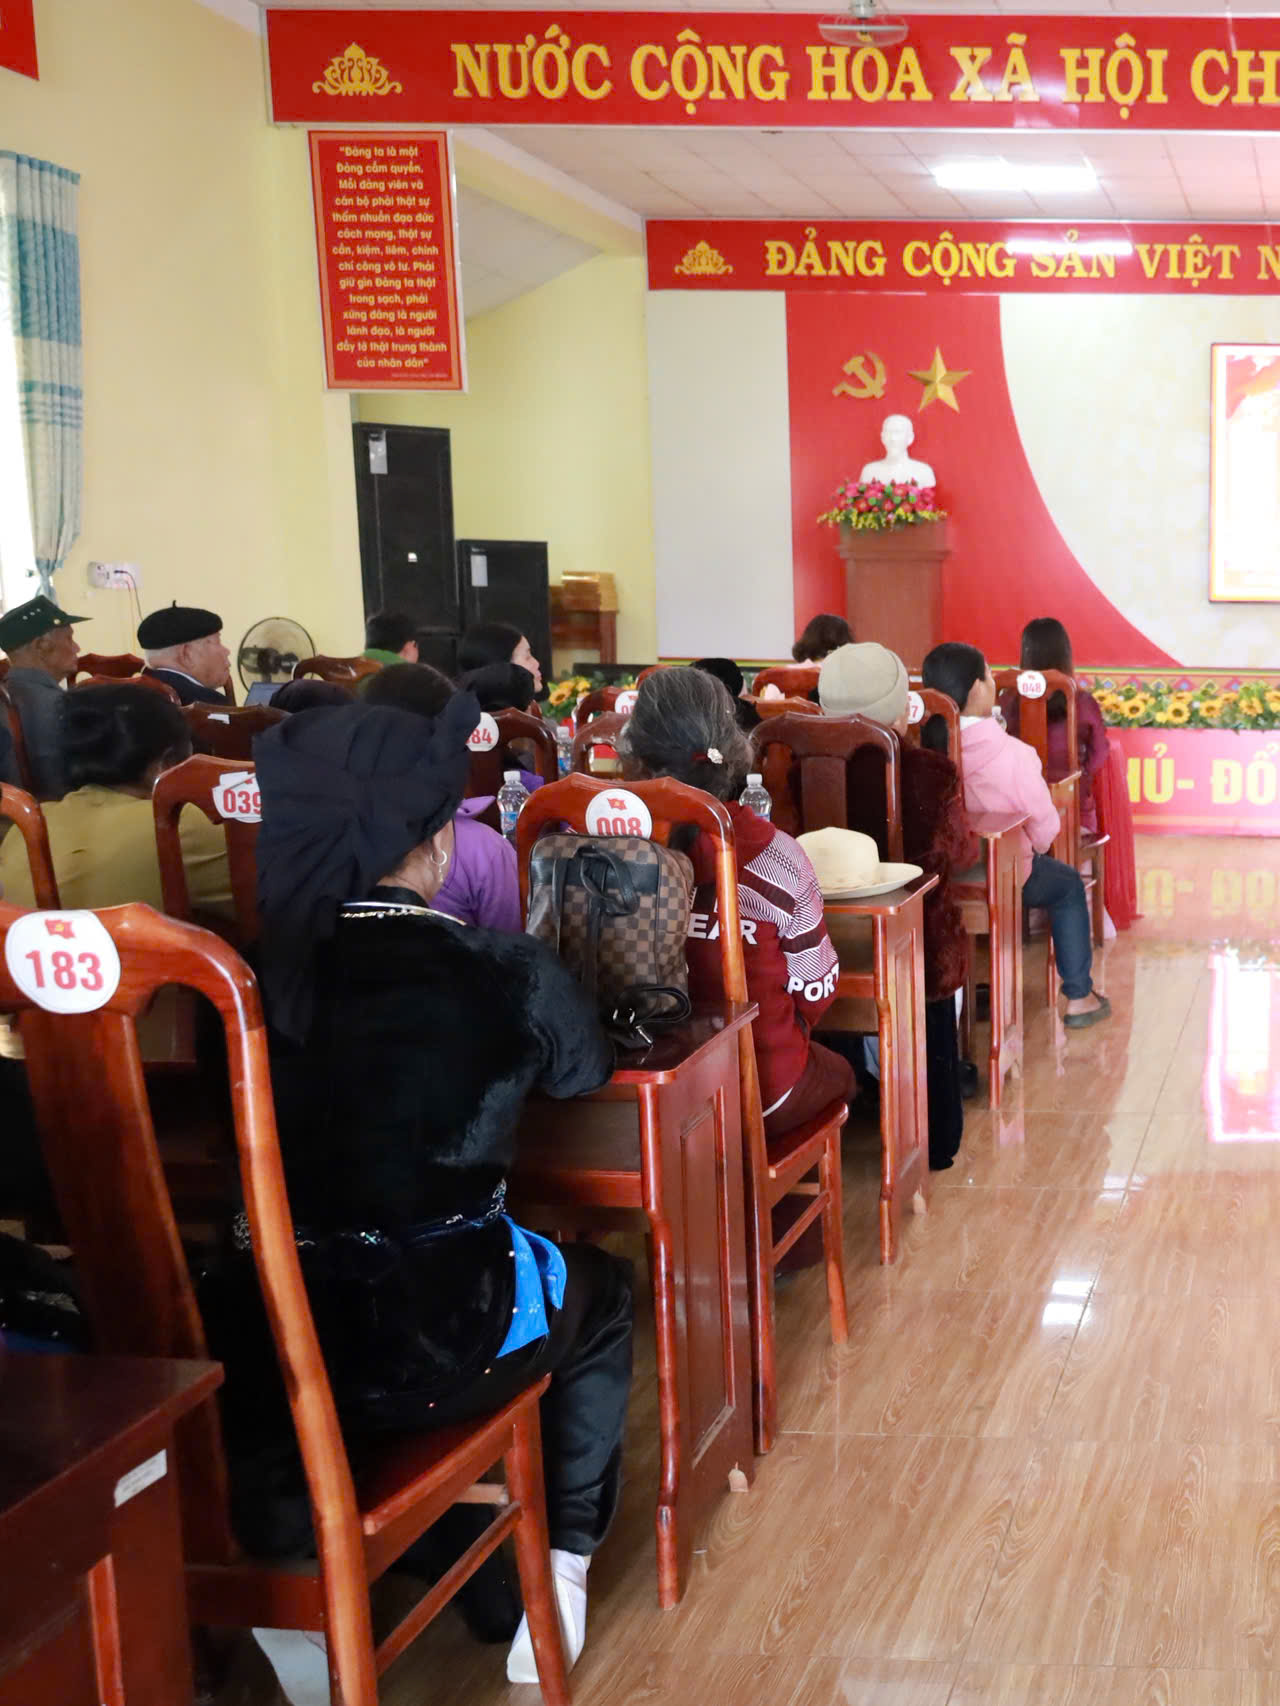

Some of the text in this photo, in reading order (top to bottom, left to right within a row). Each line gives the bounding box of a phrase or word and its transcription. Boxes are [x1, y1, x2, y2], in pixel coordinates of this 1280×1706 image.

[450, 23, 612, 100] NƯỚC
[630, 28, 790, 115] CỘNG
[950, 33, 1040, 103] XÃ
[1059, 32, 1168, 119] HỘI
[764, 227, 886, 276] ĐẢNG
[902, 230, 1016, 286] CỘNG
[1030, 228, 1116, 278] SẢN
[1136, 234, 1240, 287] VIỆT
[465, 727, 493, 745] 84
[24, 950, 104, 991] 183
